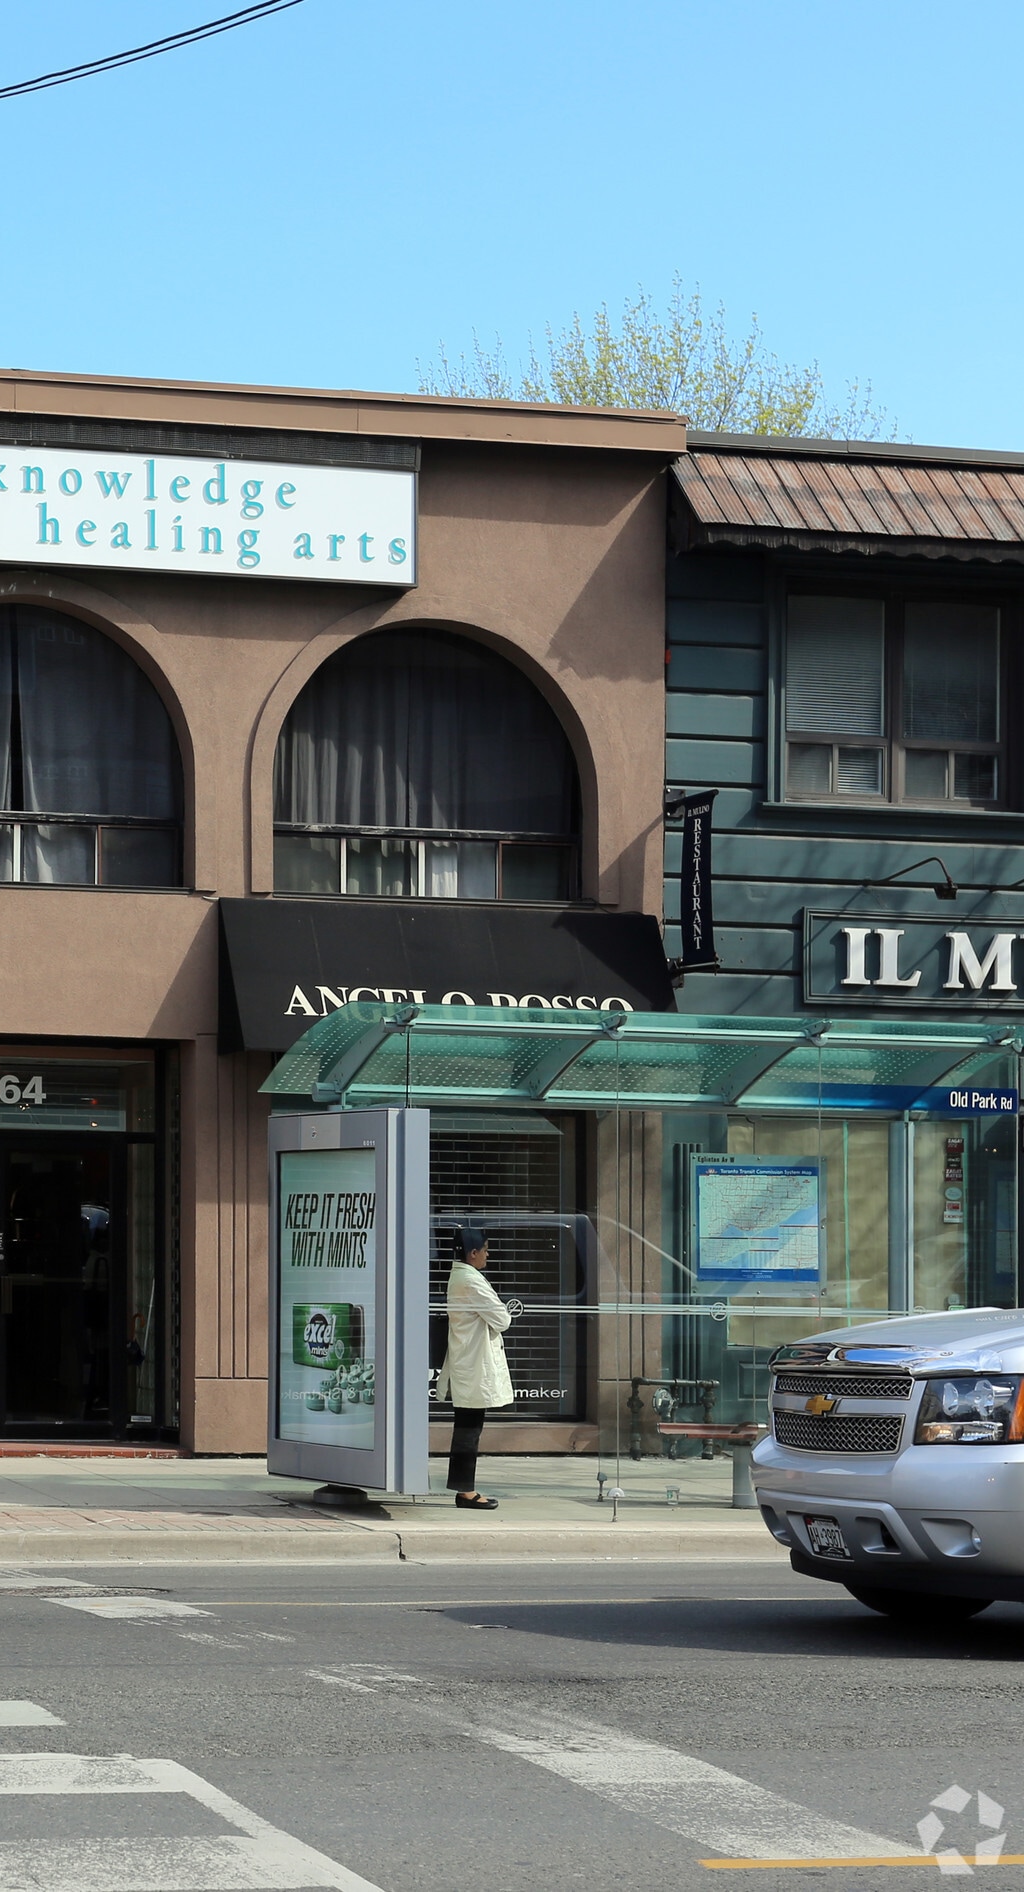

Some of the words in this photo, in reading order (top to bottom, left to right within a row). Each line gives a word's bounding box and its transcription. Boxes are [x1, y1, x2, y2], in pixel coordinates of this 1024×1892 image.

[36, 502, 261, 568] healing
[293, 531, 407, 564] arts
[692, 818, 702, 950] RESTAURANT
[841, 928, 922, 988] IL
[942, 931, 1024, 991] M
[950, 1090, 969, 1108] Old
[972, 1092, 997, 1109] Park
[1000, 1096, 1013, 1110] Rd
[285, 1193, 318, 1230] KEEP
[320, 1192, 336, 1230] IT
[336, 1192, 375, 1230] FRESH
[291, 1231, 324, 1268] WITH
[326, 1231, 367, 1269] MINTS.
[304, 1314, 336, 1344] excel
[311, 1346, 329, 1356] mints
[515, 1386, 568, 1399] maker
